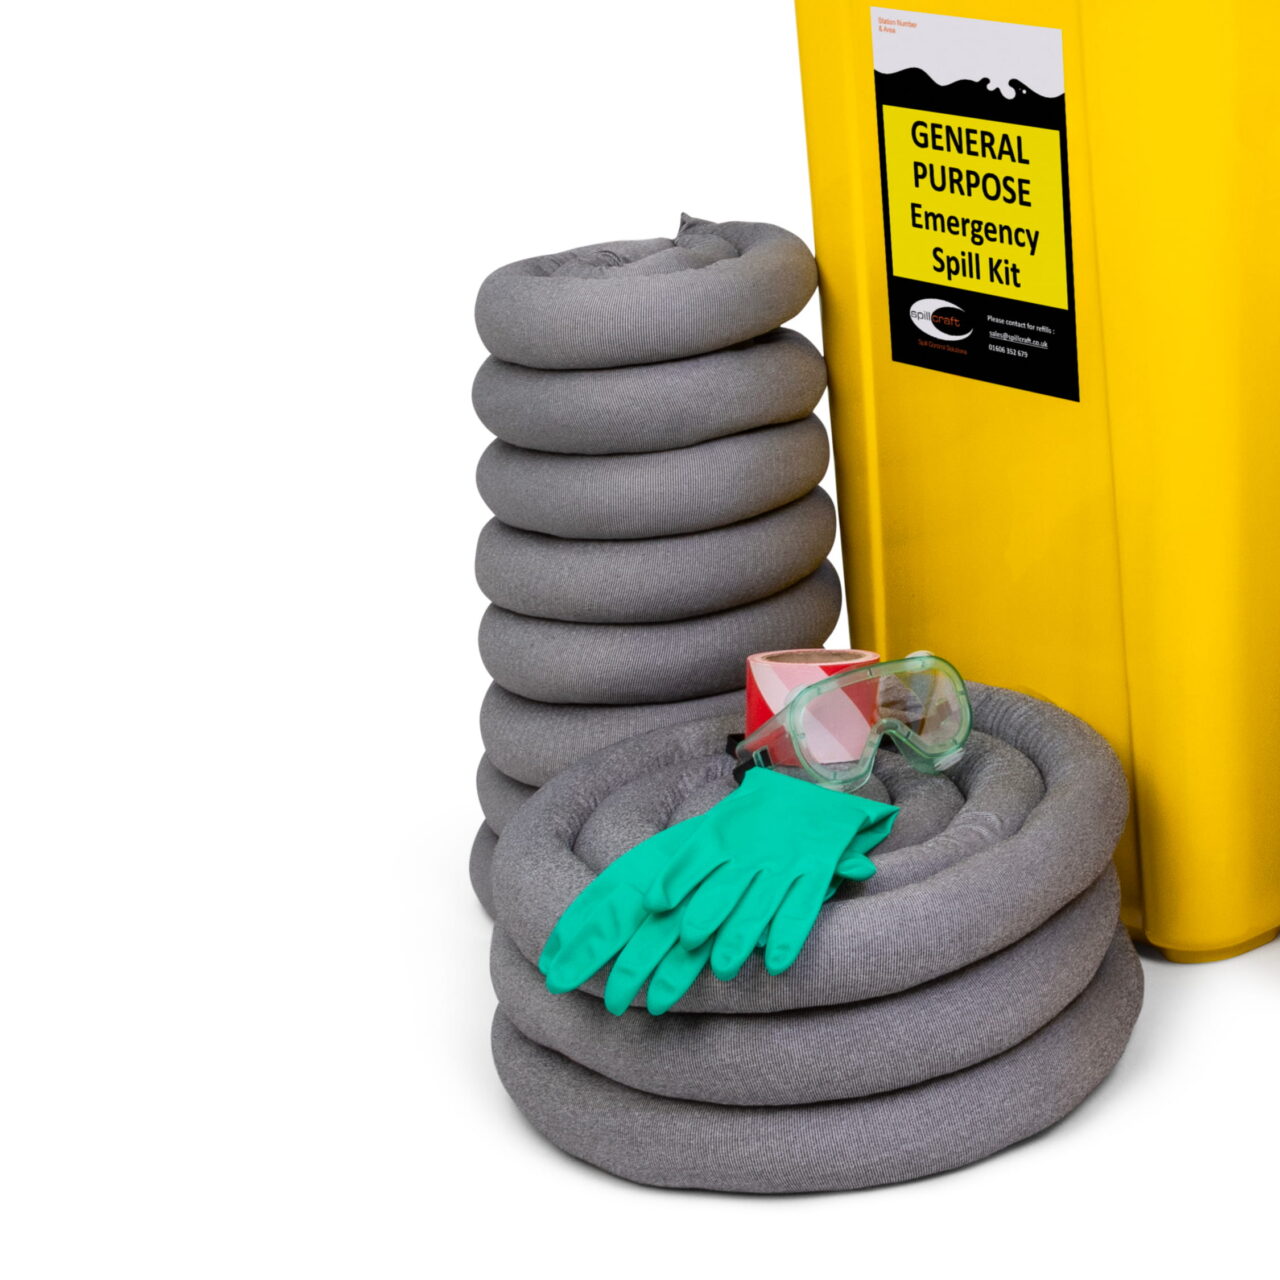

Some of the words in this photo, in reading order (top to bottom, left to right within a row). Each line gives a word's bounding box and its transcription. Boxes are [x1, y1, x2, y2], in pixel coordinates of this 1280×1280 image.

[897, 19, 917, 28] Number
[911, 120, 1030, 165] GENERAL
[913, 161, 1032, 207] PURPOSE
[910, 202, 1040, 256] Emergency
[932, 246, 981, 281] Spill
[988, 257, 1021, 288] Kit
[987, 315, 1005, 324] Please
[1005, 320, 1026, 329] contact
[1026, 322, 1036, 330] for
[1006, 348, 1017, 356] 352
